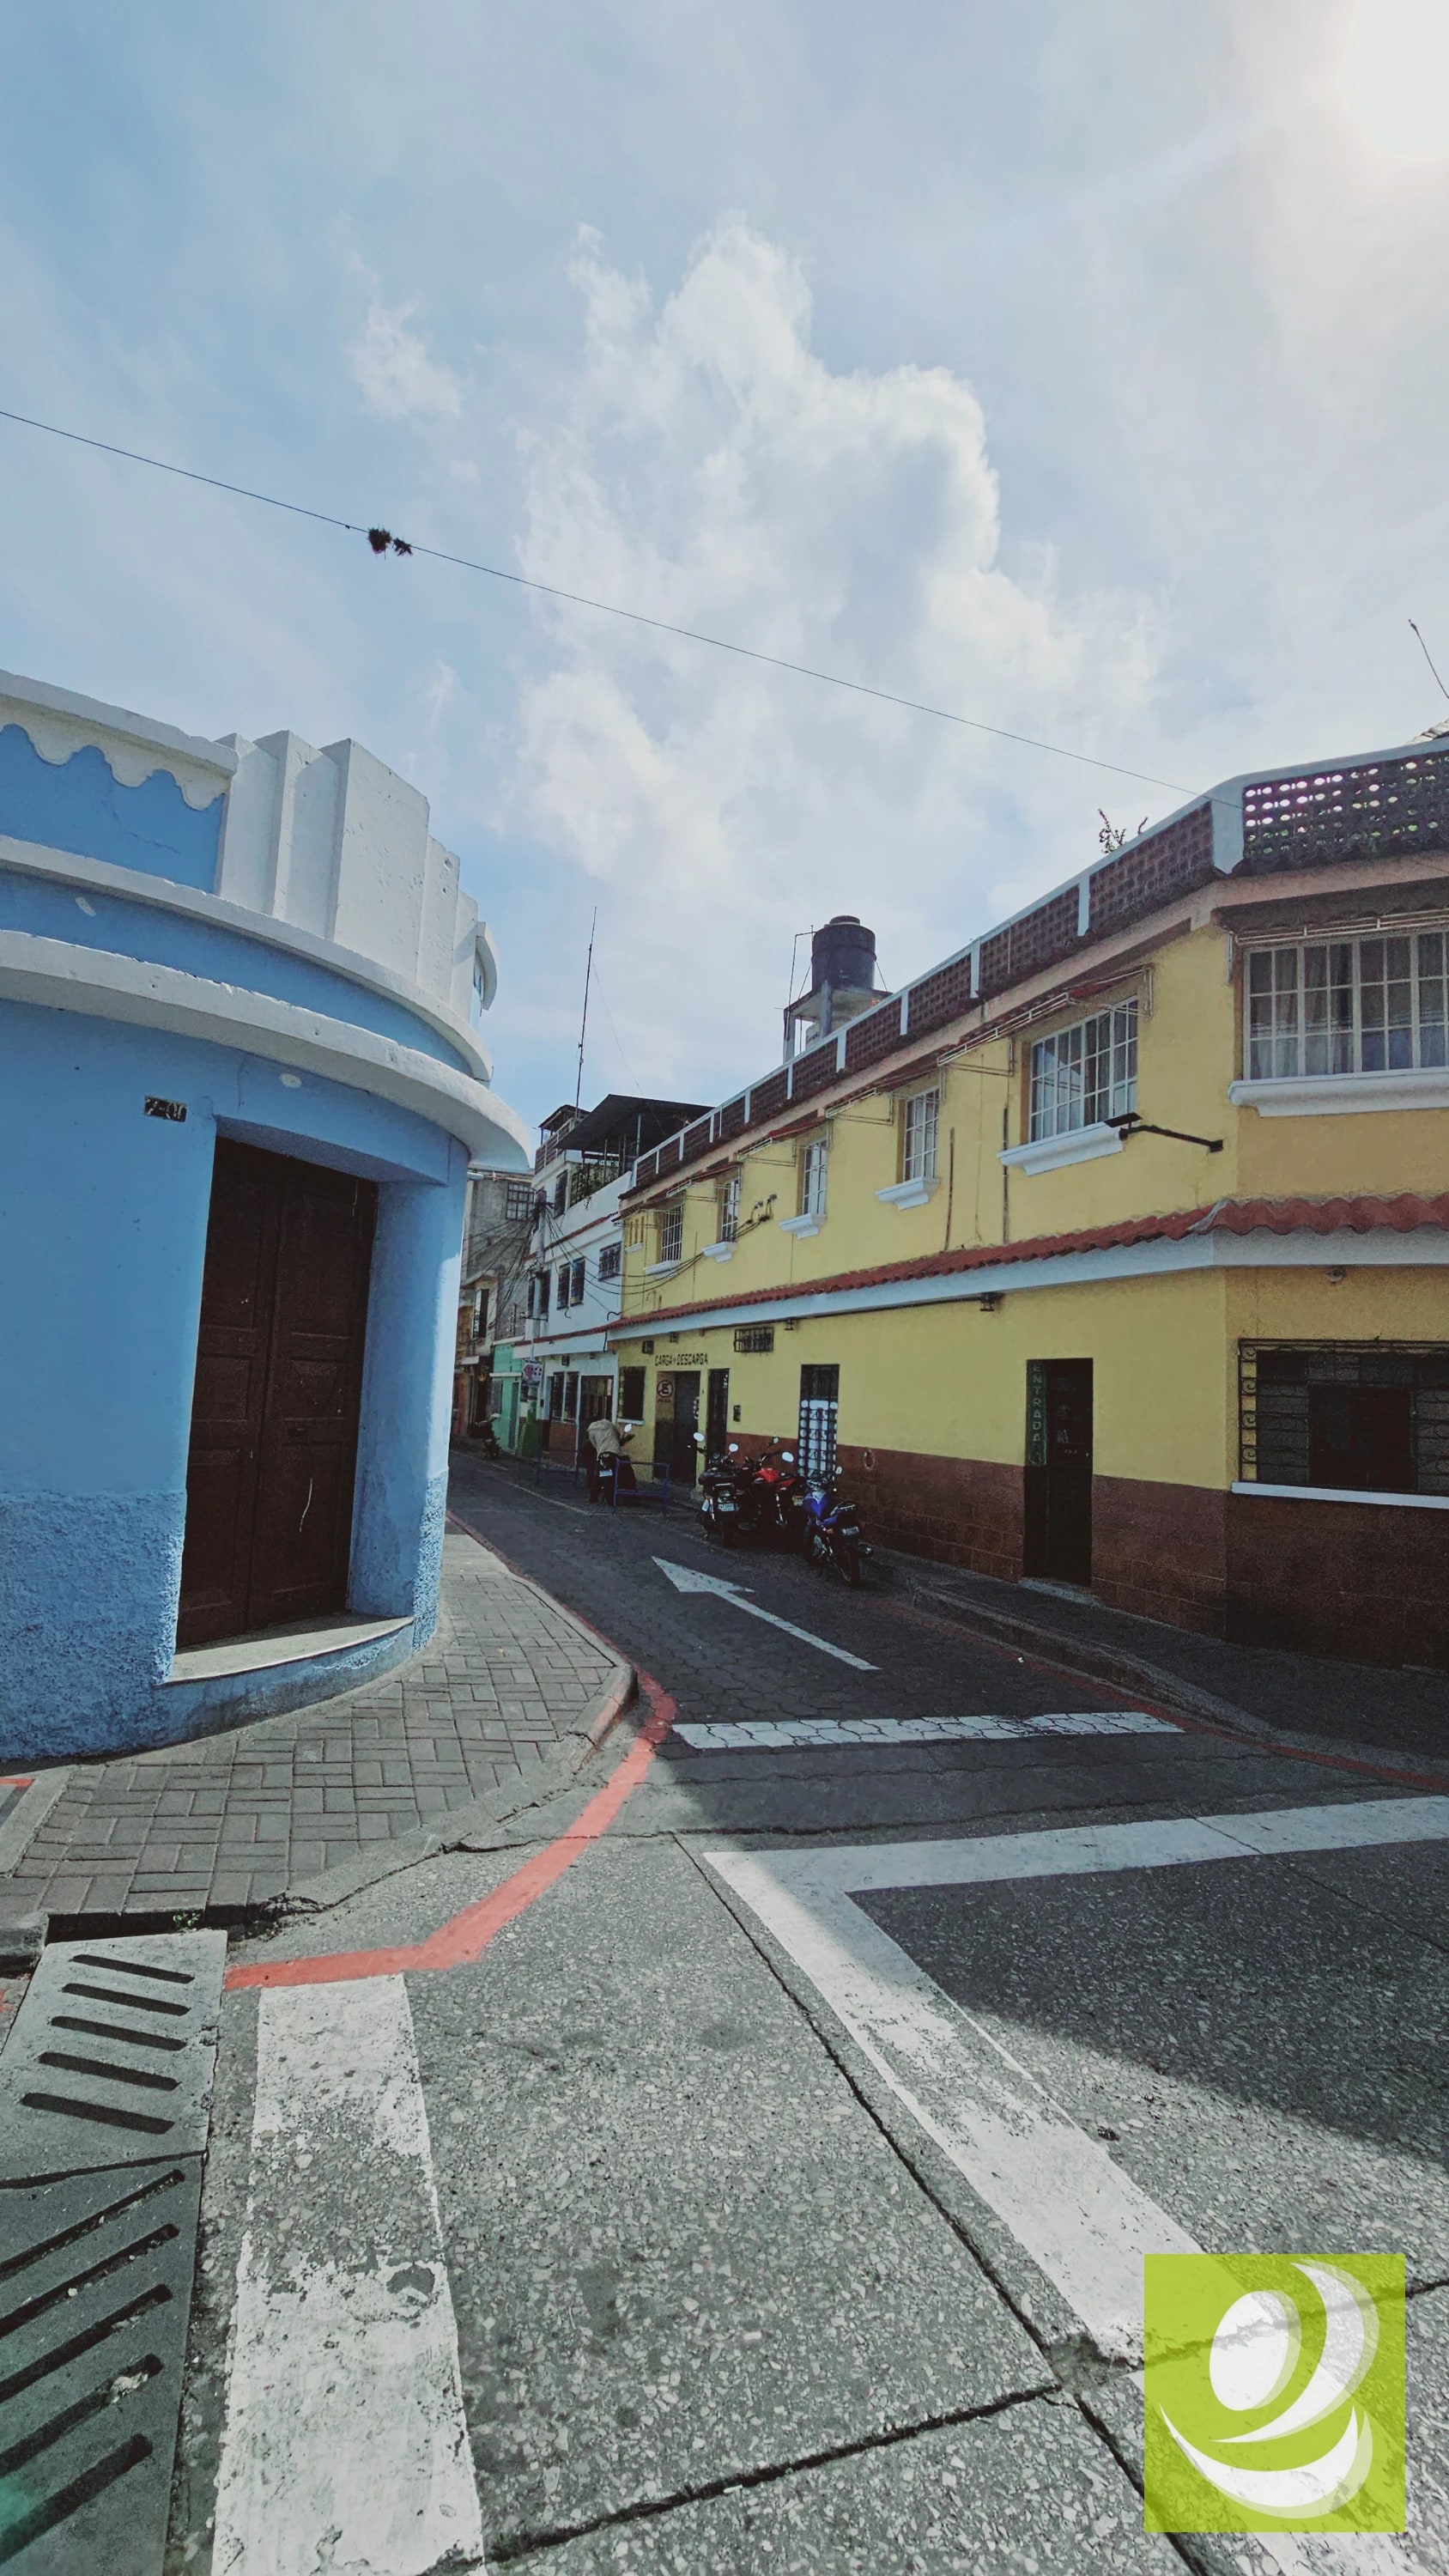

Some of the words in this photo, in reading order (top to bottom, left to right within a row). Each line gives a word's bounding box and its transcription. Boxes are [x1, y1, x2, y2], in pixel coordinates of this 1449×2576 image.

[655, 1354, 672, 1366] CARGA
[676, 1352, 708, 1365] DESCARGA
[1032, 1362, 1042, 1443] ENTRADA
